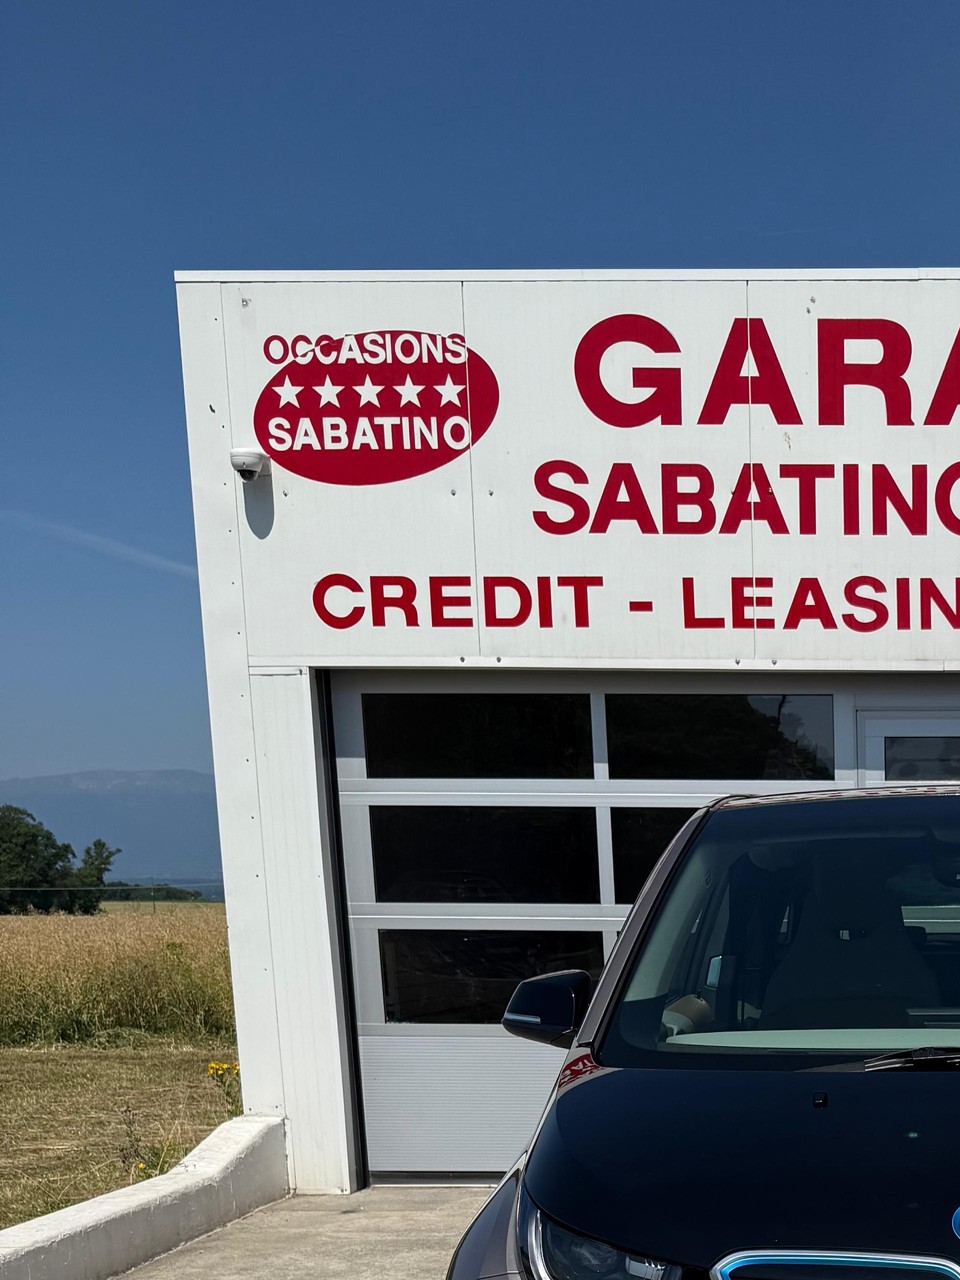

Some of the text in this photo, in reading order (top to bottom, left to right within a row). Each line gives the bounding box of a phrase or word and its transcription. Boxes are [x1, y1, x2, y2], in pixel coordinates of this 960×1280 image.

[263, 334, 468, 365] OCCASIONS
[268, 415, 471, 451] SABATINO
[313, 574, 603, 629] CREDIT
